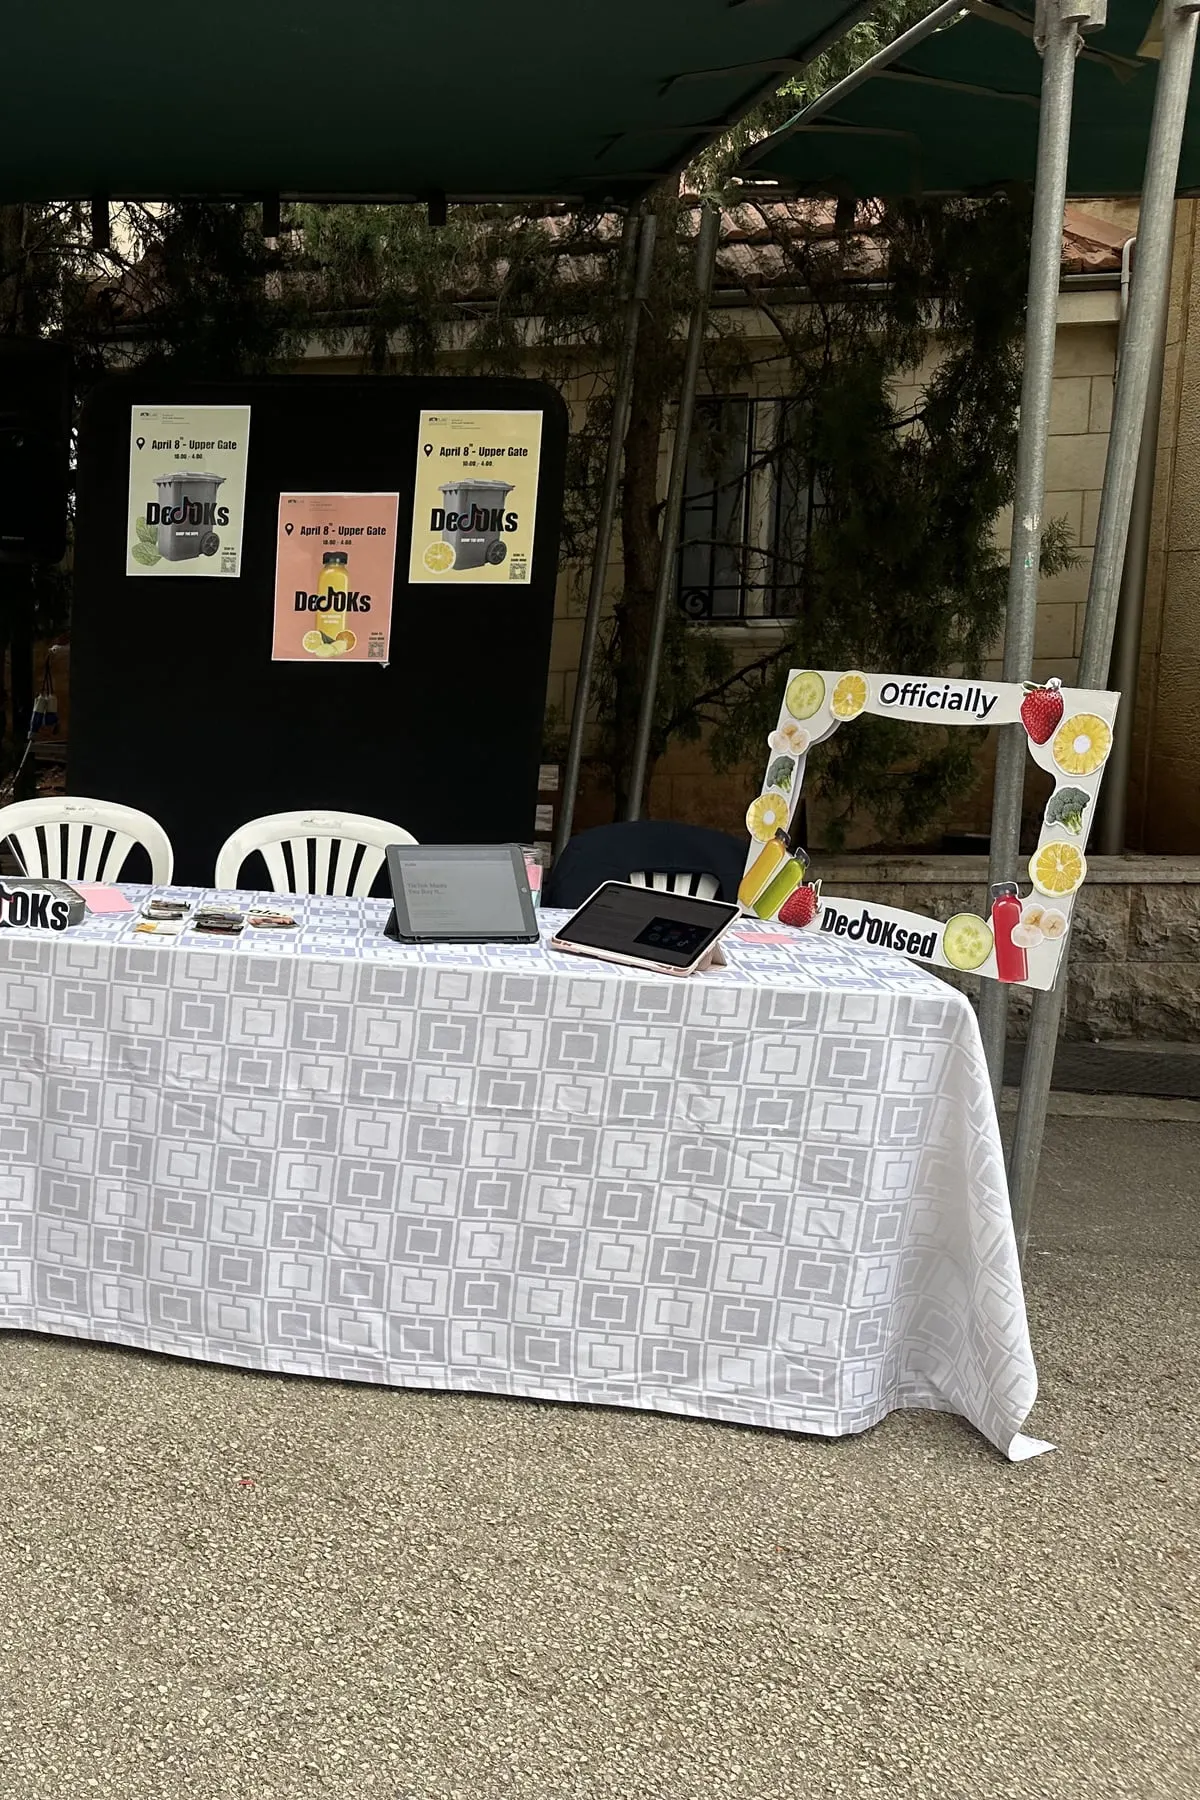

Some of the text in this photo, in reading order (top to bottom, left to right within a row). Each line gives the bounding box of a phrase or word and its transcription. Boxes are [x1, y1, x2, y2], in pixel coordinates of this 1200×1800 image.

[151, 440, 172, 450] April
[189, 440, 215, 451] Upper
[217, 440, 237, 450] Gate
[439, 446, 460, 457] April
[478, 447, 505, 457] Upper
[507, 447, 528, 457] Gate
[300, 526, 320, 537] April
[338, 526, 364, 537] Upper
[366, 526, 387, 536] Gate
[880, 682, 998, 719] Officially
